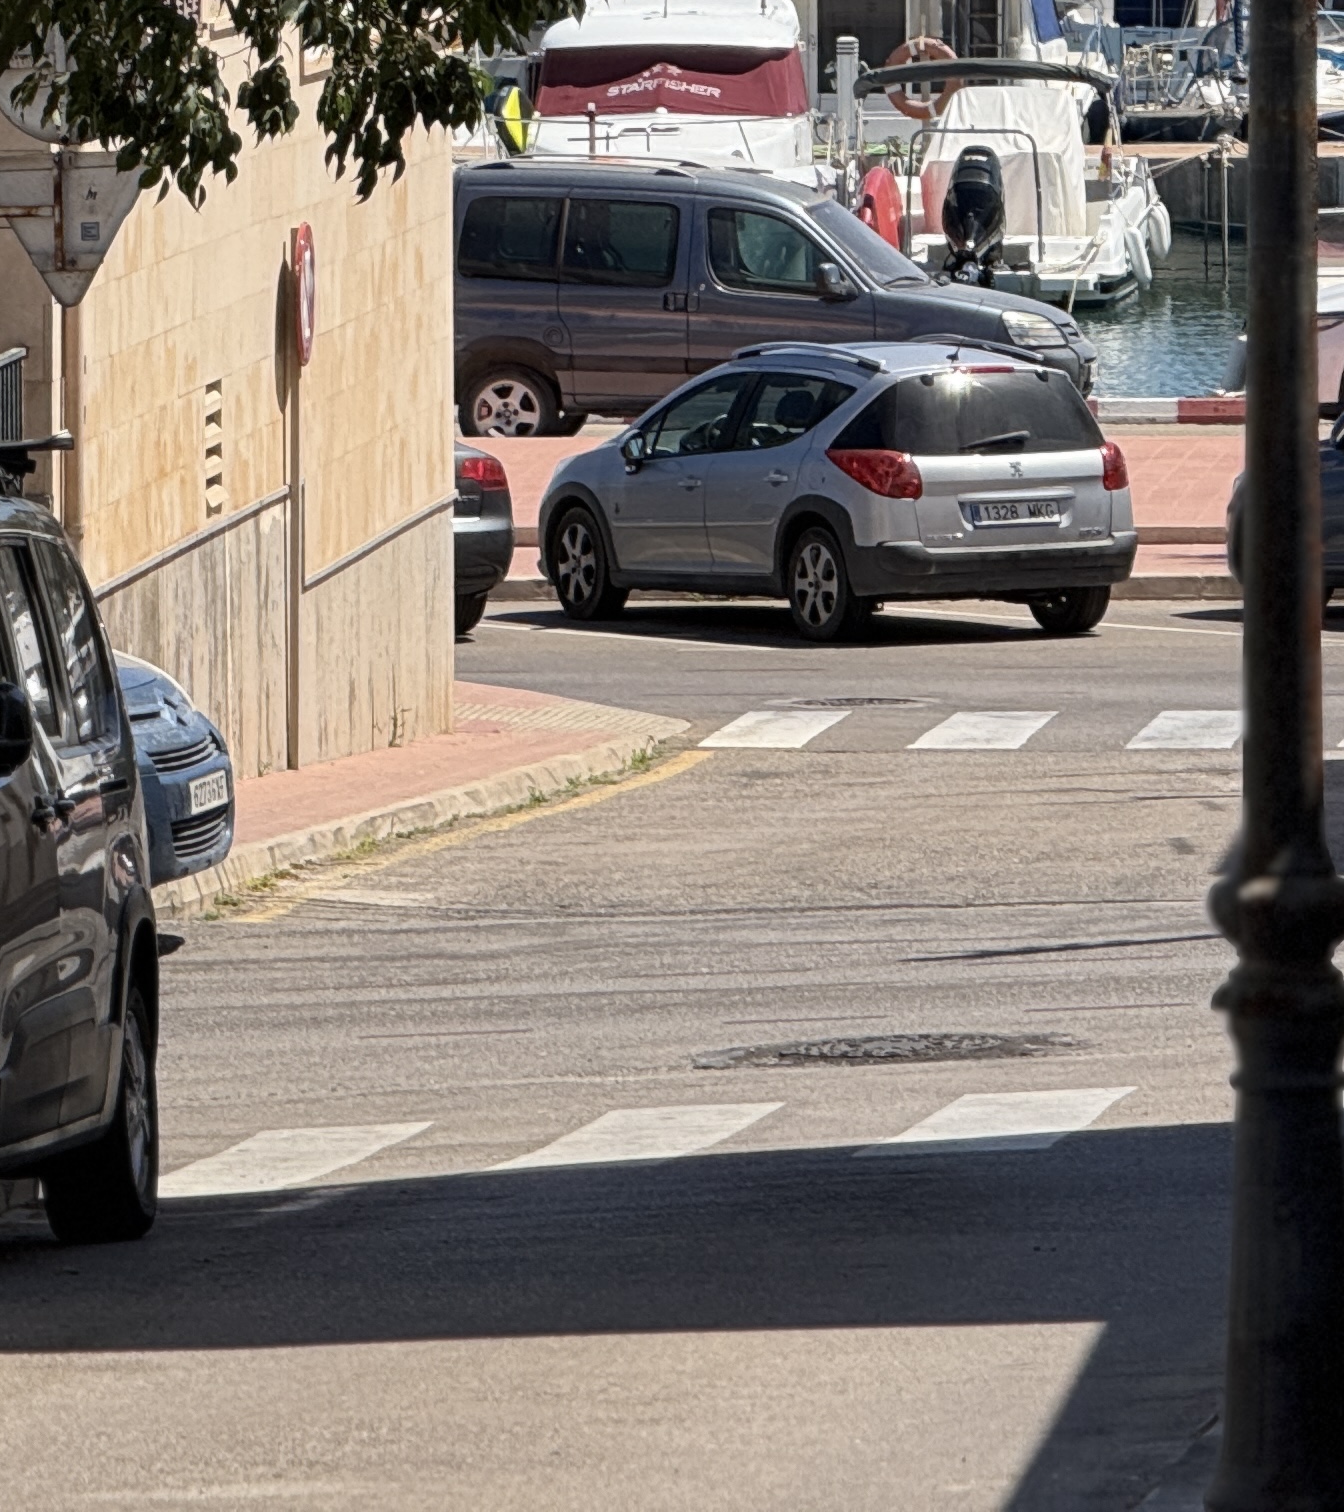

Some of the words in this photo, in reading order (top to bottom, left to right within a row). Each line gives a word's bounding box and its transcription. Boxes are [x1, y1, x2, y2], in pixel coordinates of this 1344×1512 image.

[606, 78, 722, 98] STARFISHER
[984, 505, 1019, 521] 1328
[1028, 503, 1055, 519] MKG
